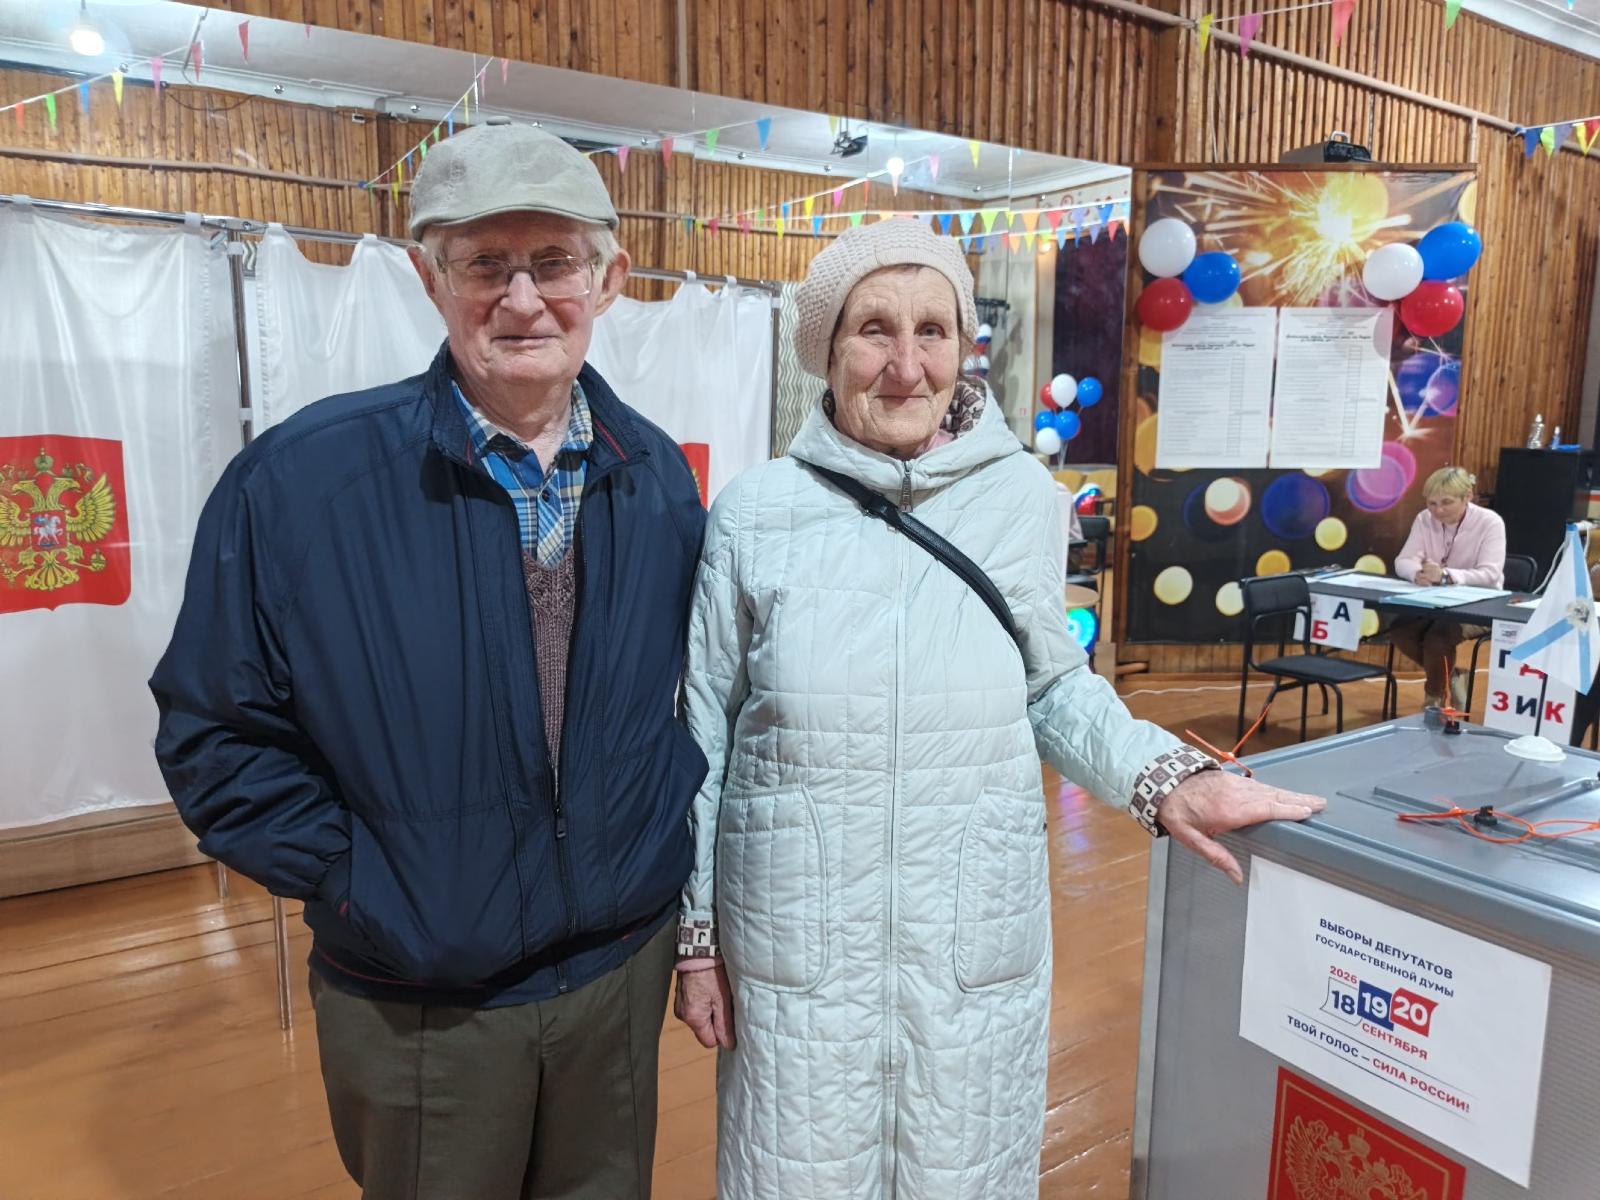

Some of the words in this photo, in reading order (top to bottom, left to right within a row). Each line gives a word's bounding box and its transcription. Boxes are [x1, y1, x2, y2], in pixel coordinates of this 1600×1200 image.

[1311, 619, 1329, 641] Б
[1332, 601, 1351, 623] А
[1315, 933, 1418, 982] ГОСУДАРСТВЕННОЙ
[1419, 977, 1455, 998] ДУМЫ
[1319, 917, 1373, 949] ВЫБОРЫ
[1375, 939, 1454, 981] ДЕПУТАТОВ
[1329, 965, 1358, 985] 2026
[1331, 989, 1356, 1016] 18
[1362, 991, 1389, 1020] 19
[1393, 995, 1428, 1026] 20
[1362, 1023, 1428, 1060] СЕНТЯБРЯ
[1287, 1014, 1318, 1038] ТВОЙ
[1319, 1031, 1359, 1058] ГОЛОС
[1372, 1057, 1408, 1083] СИЛА
[1410, 1076, 1470, 1112] РОССИИ!
